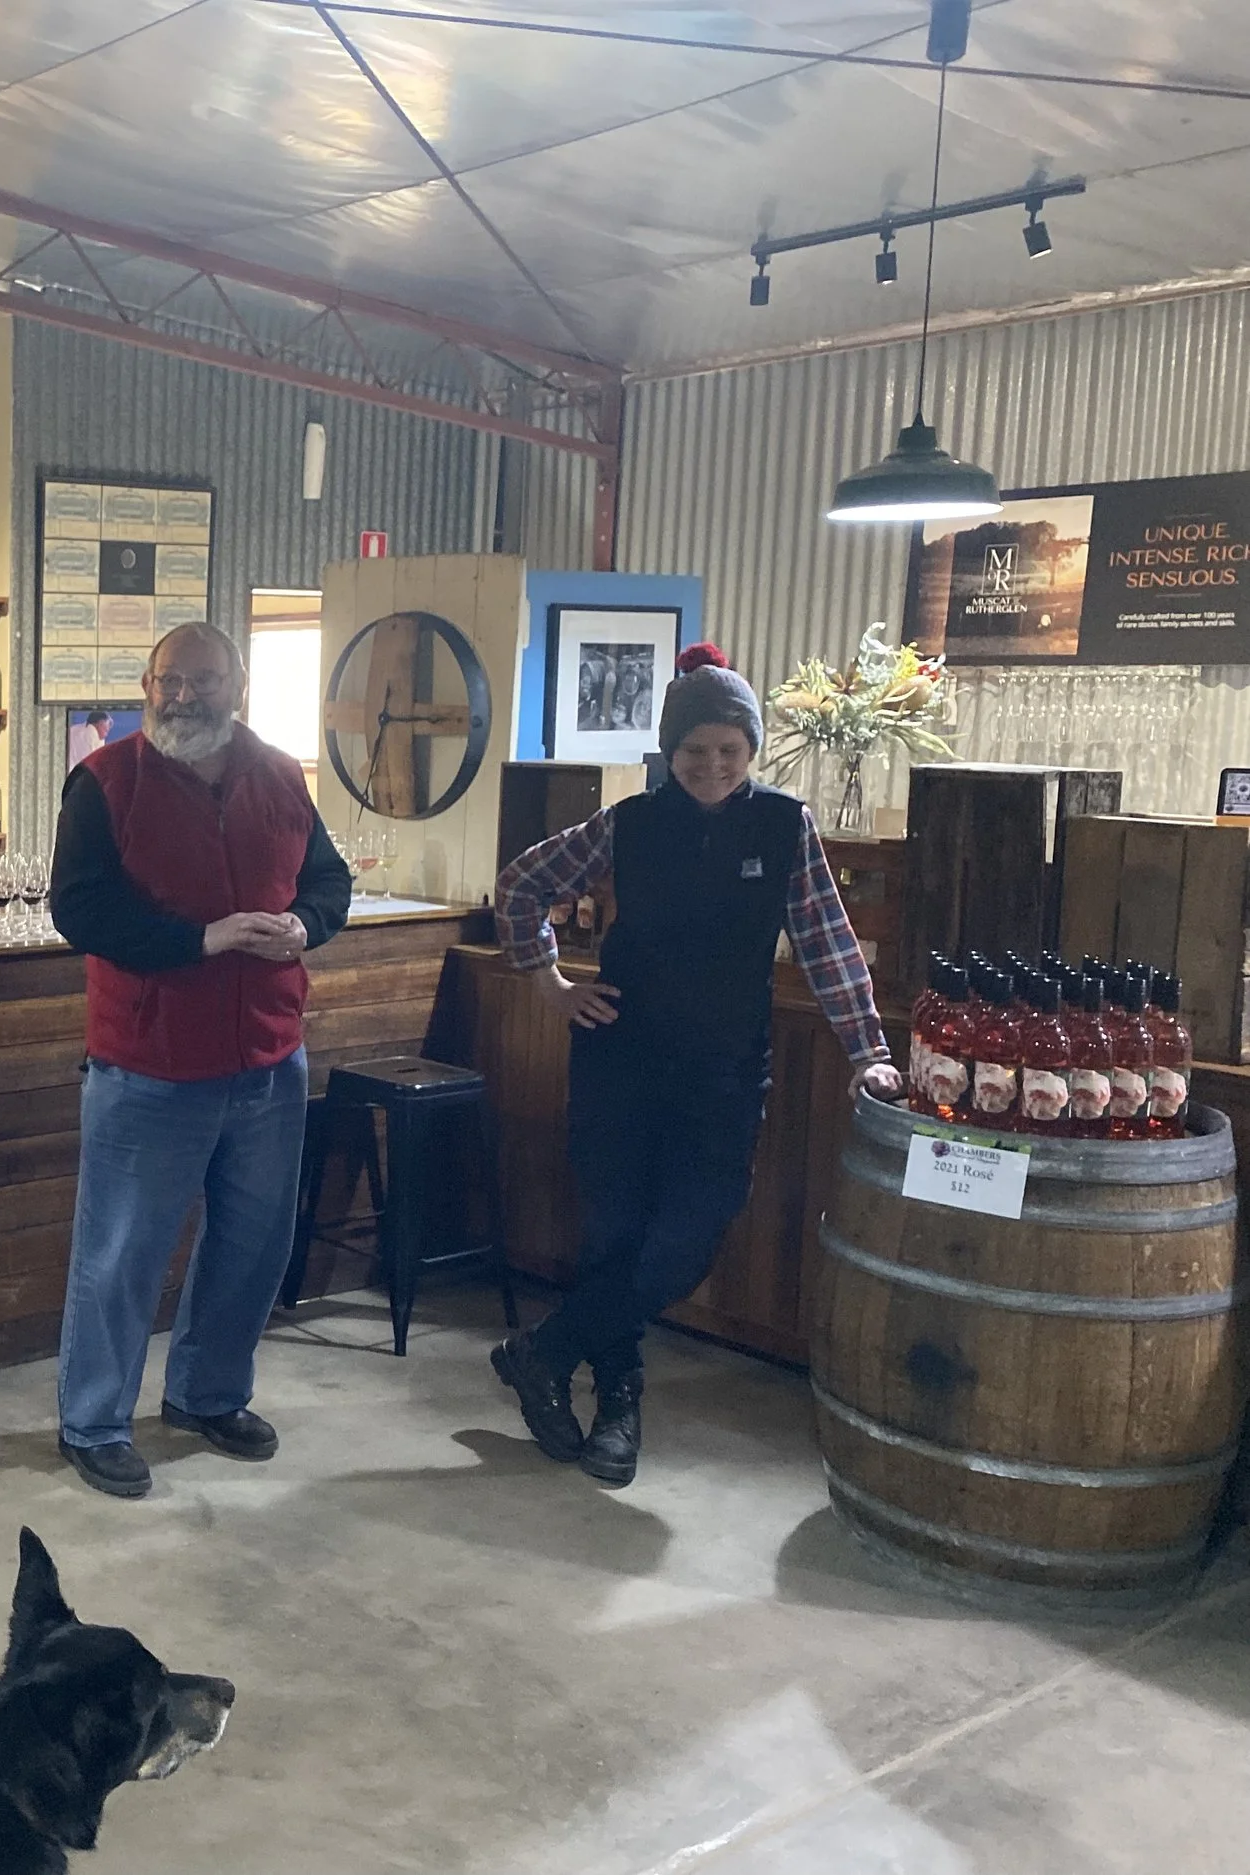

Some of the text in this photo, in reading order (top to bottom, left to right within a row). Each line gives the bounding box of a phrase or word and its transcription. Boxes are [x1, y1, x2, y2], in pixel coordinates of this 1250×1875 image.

[1145, 522, 1229, 543] UNIQUE
[1110, 546, 1199, 567] INTENSE
[1126, 568, 1240, 588] SENSUOUS.
[965, 604, 1028, 615] RUTHERGLEN
[972, 596, 1011, 606] MUSCAT
[934, 1160, 994, 1181] 2021 Rosé
